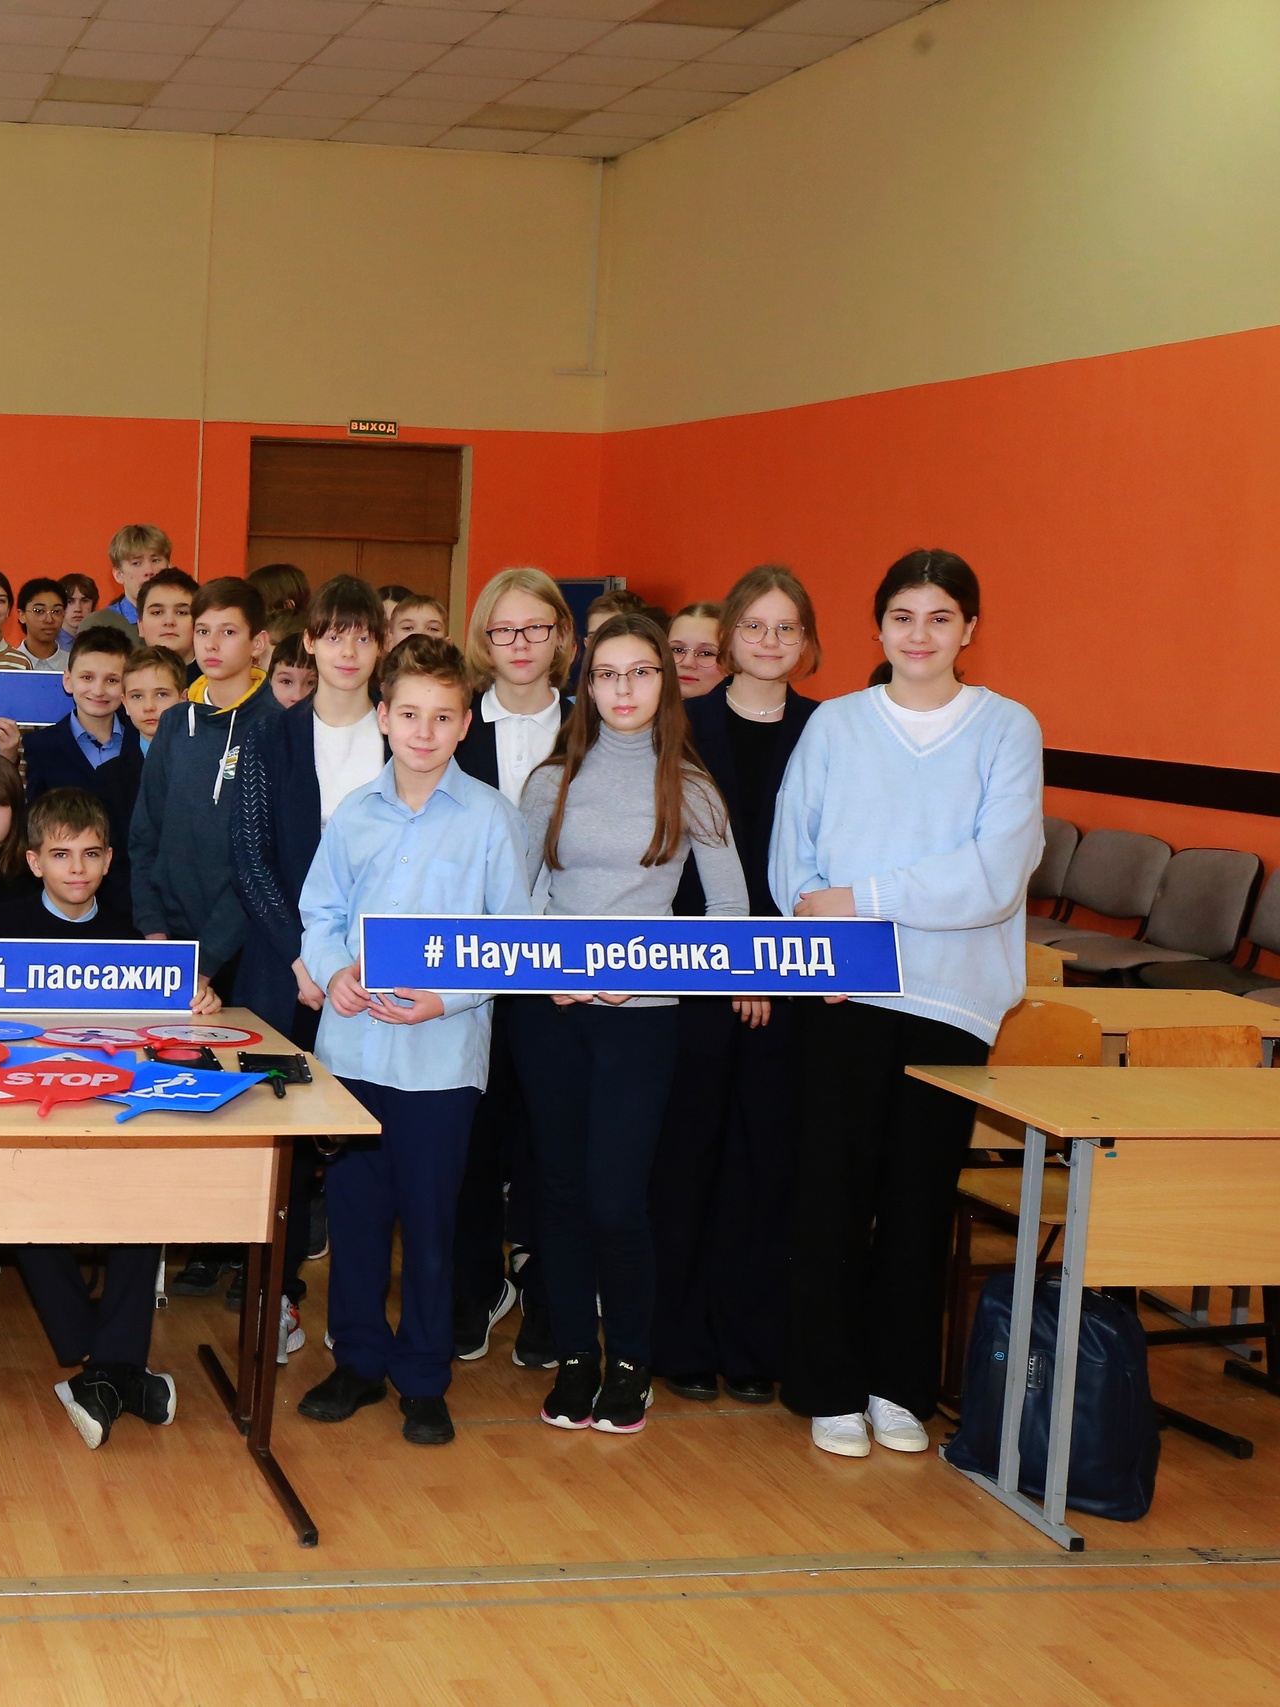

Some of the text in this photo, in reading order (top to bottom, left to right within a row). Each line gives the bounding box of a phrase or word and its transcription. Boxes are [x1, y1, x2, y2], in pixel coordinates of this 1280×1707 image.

[351, 421, 395, 434] ВЫХОД
[424, 934, 836, 977] # Научи_ребенка_ПДД
[3, 1072, 119, 1087] STOP
